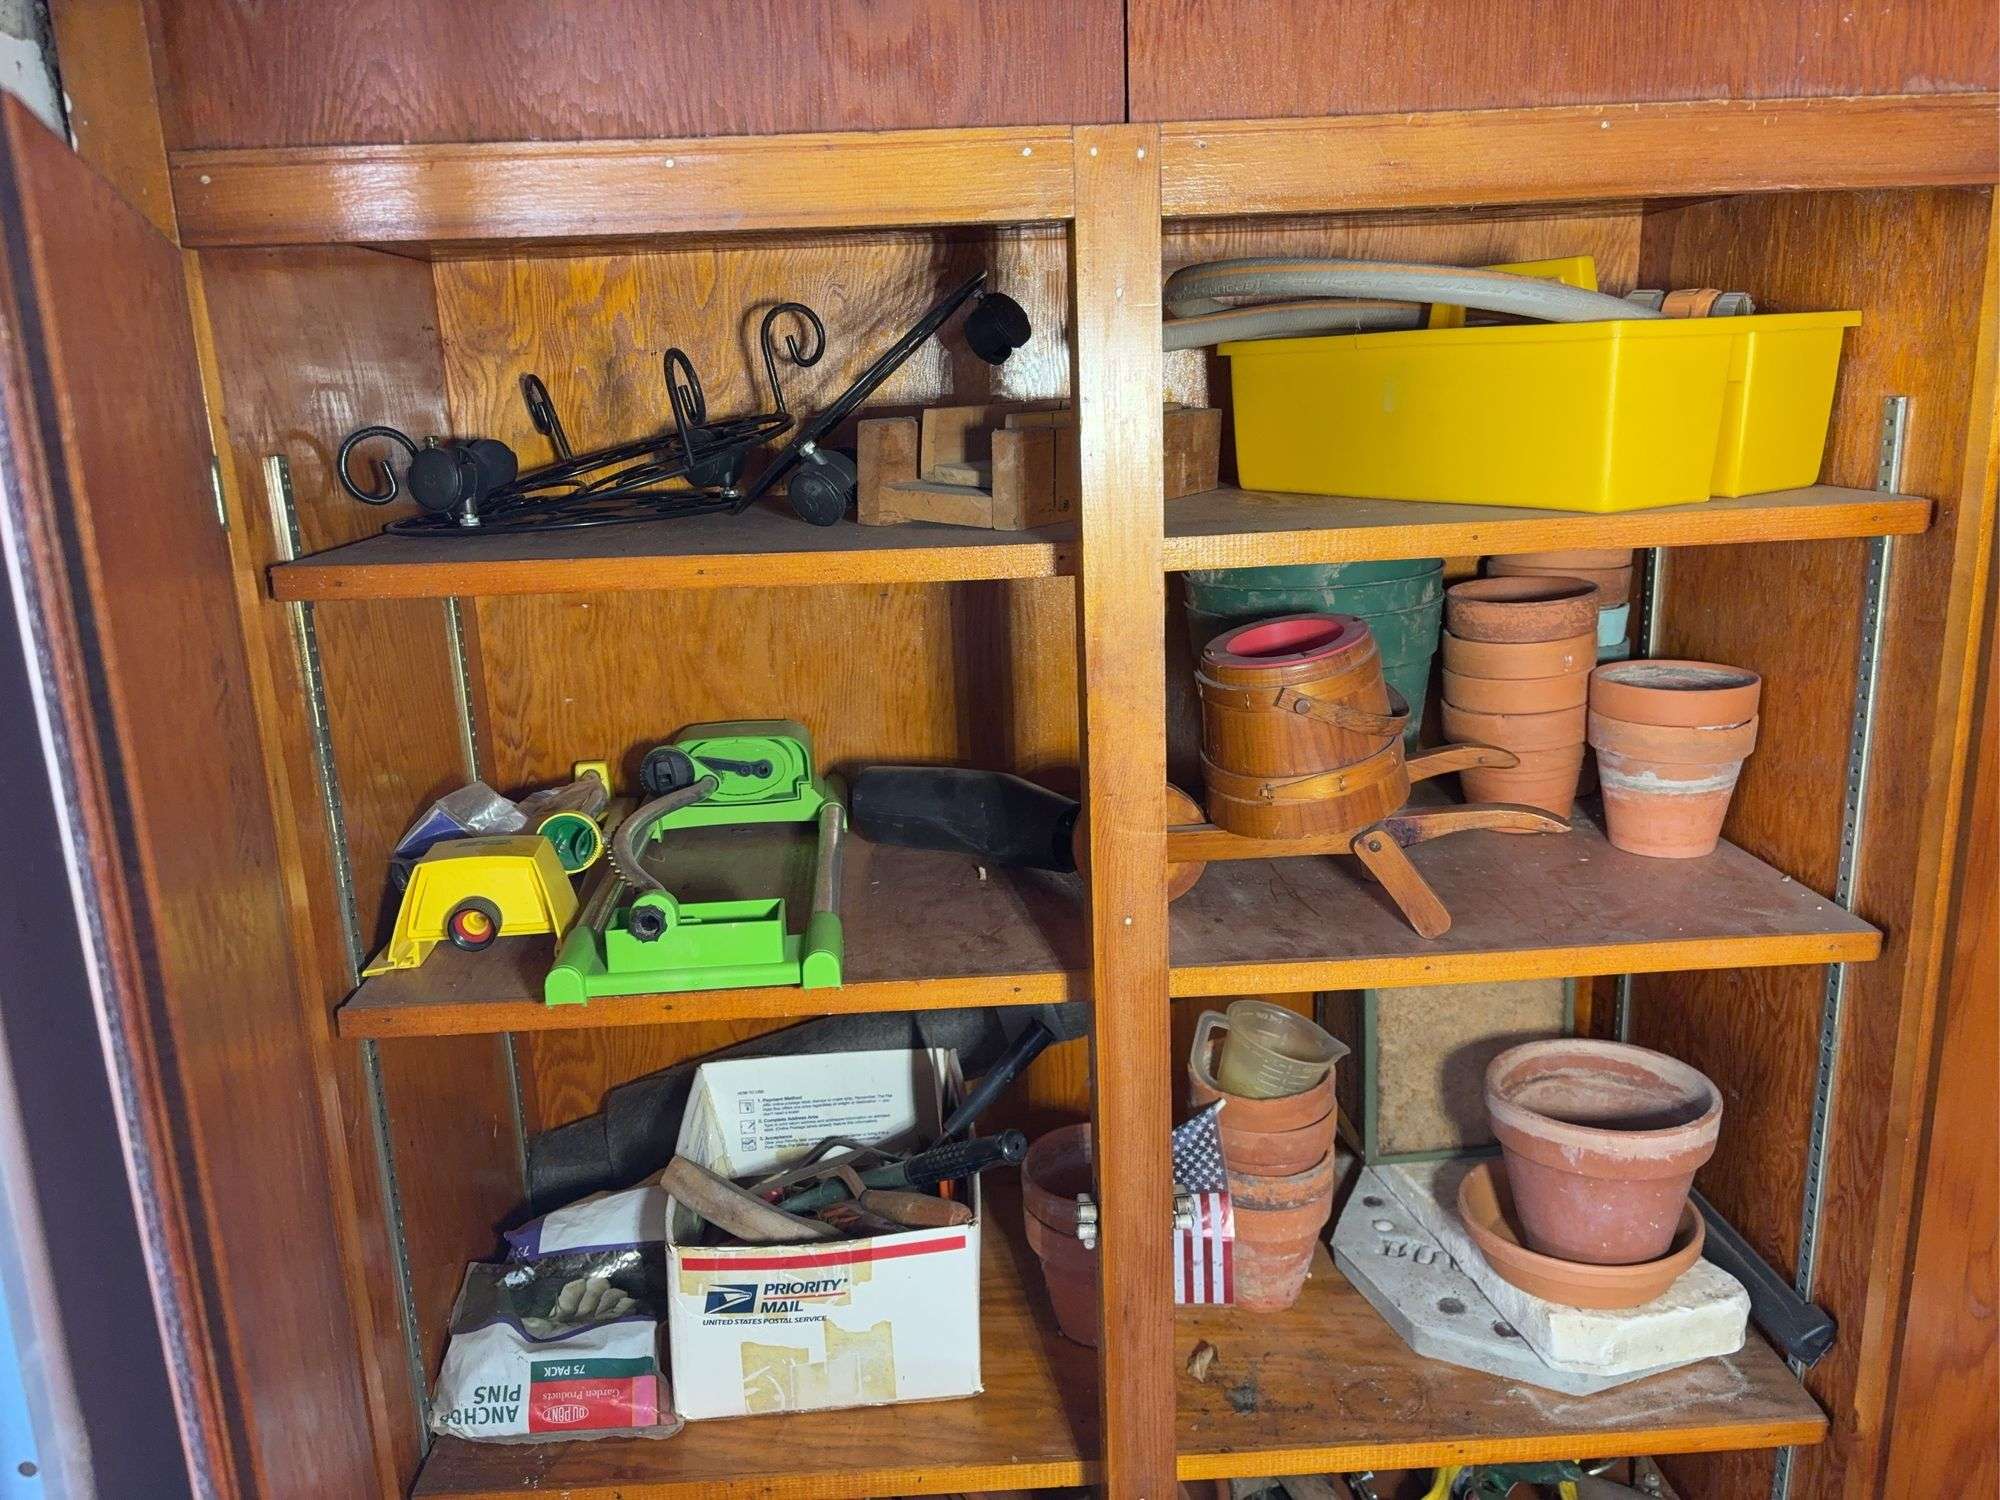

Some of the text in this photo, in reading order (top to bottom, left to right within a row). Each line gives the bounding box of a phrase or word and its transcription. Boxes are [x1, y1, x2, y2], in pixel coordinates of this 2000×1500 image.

[763, 1279, 843, 1295] PRIORITY
[760, 1300, 804, 1313] MAIL
[794, 1314, 827, 1323] SERVICE
[543, 1364, 586, 1377] 75 PACK
[473, 1384, 522, 1405] PINS
[542, 1388, 621, 1402] Garden Products
